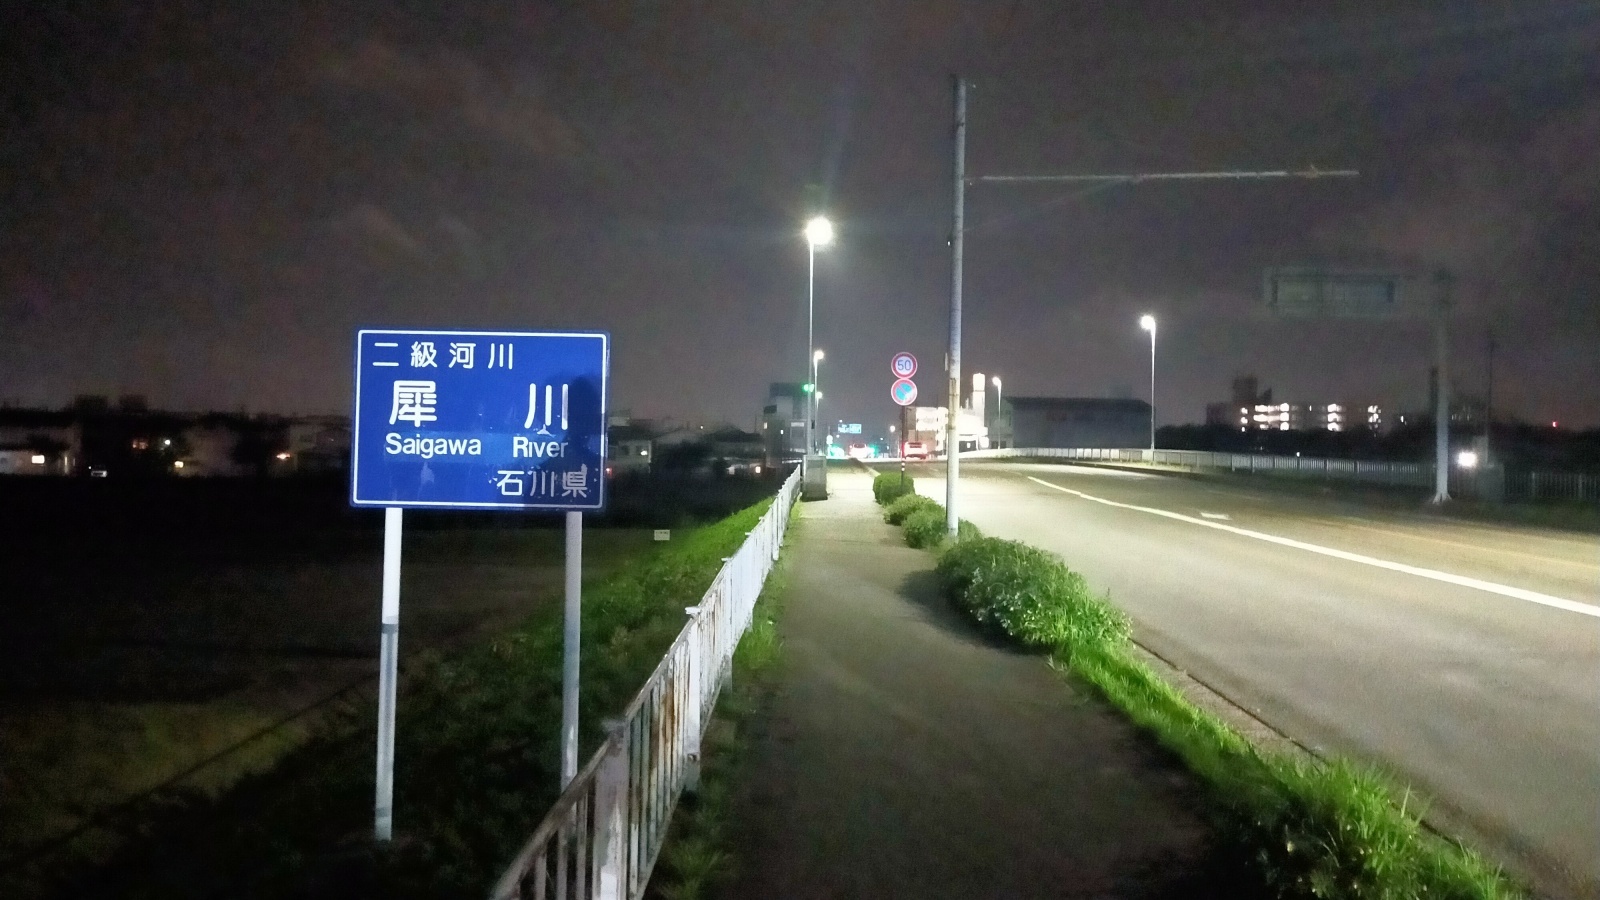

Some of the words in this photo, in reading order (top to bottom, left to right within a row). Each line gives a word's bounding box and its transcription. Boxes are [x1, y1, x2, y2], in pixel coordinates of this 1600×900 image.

[373, 341, 514, 369] 二級河川
[897, 360, 912, 371] 50
[385, 433, 482, 459] Saigawa
[512, 436, 569, 458] River
[496, 469, 588, 498] 石川県
